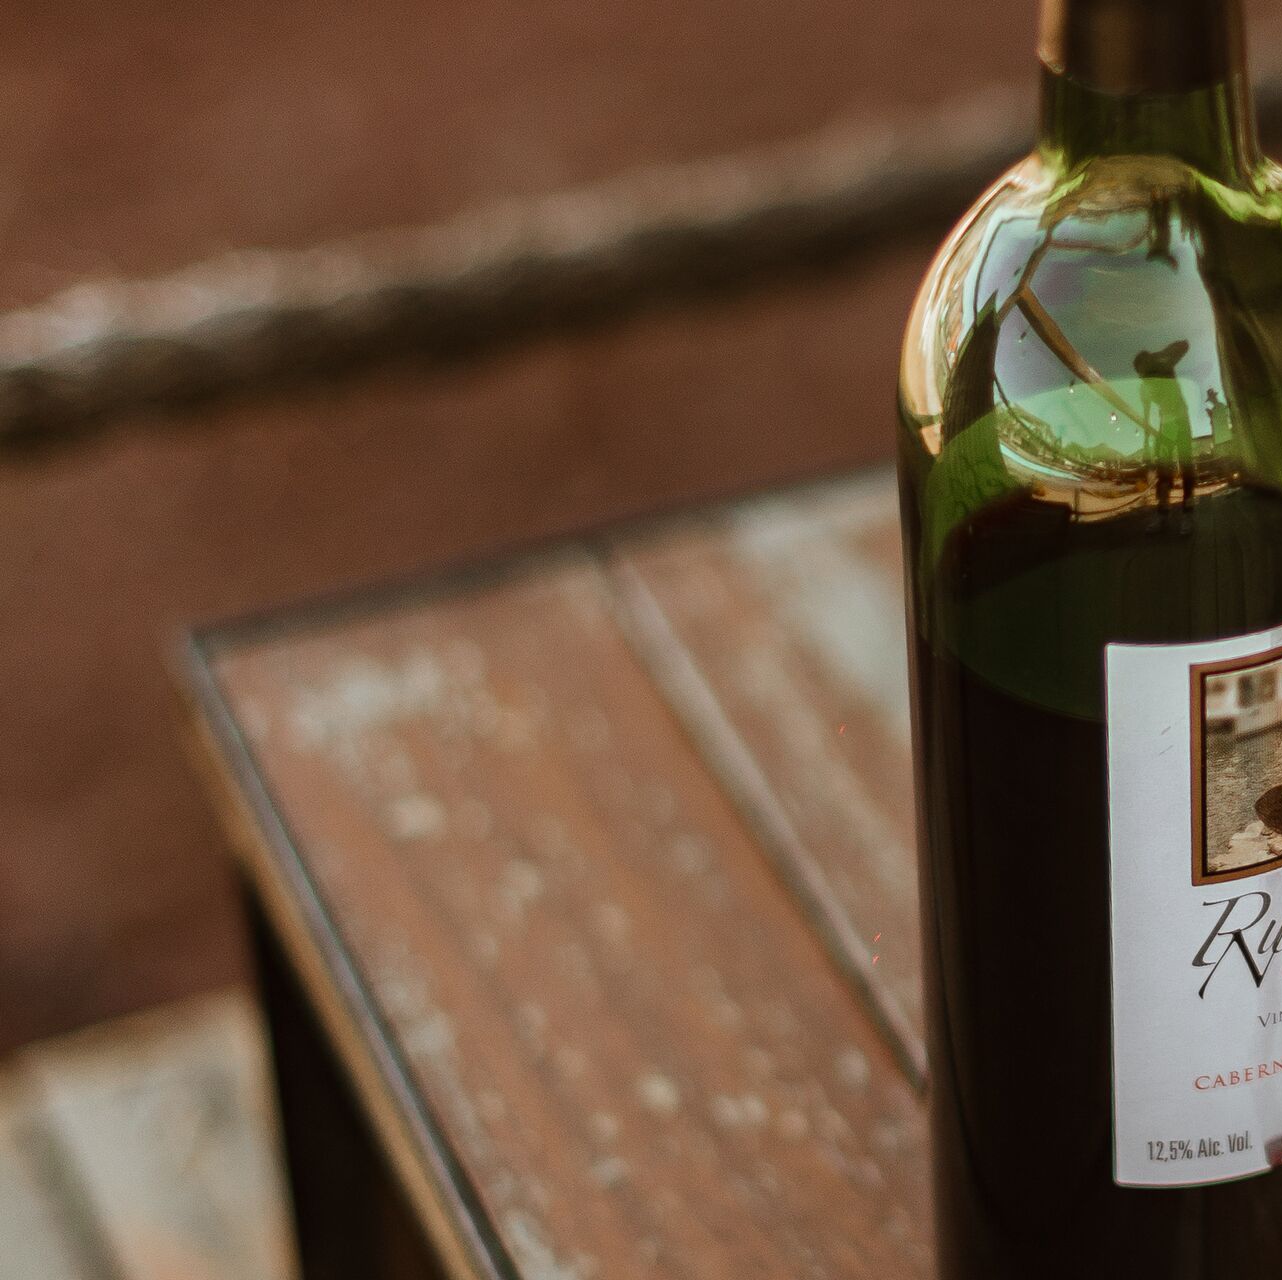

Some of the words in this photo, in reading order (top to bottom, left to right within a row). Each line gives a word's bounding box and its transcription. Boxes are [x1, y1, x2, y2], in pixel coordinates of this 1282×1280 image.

[1147, 1139, 1193, 1162] 12,5%
[1197, 1136, 1225, 1158] Alc.
[1227, 1129, 1253, 1153] Vol.
